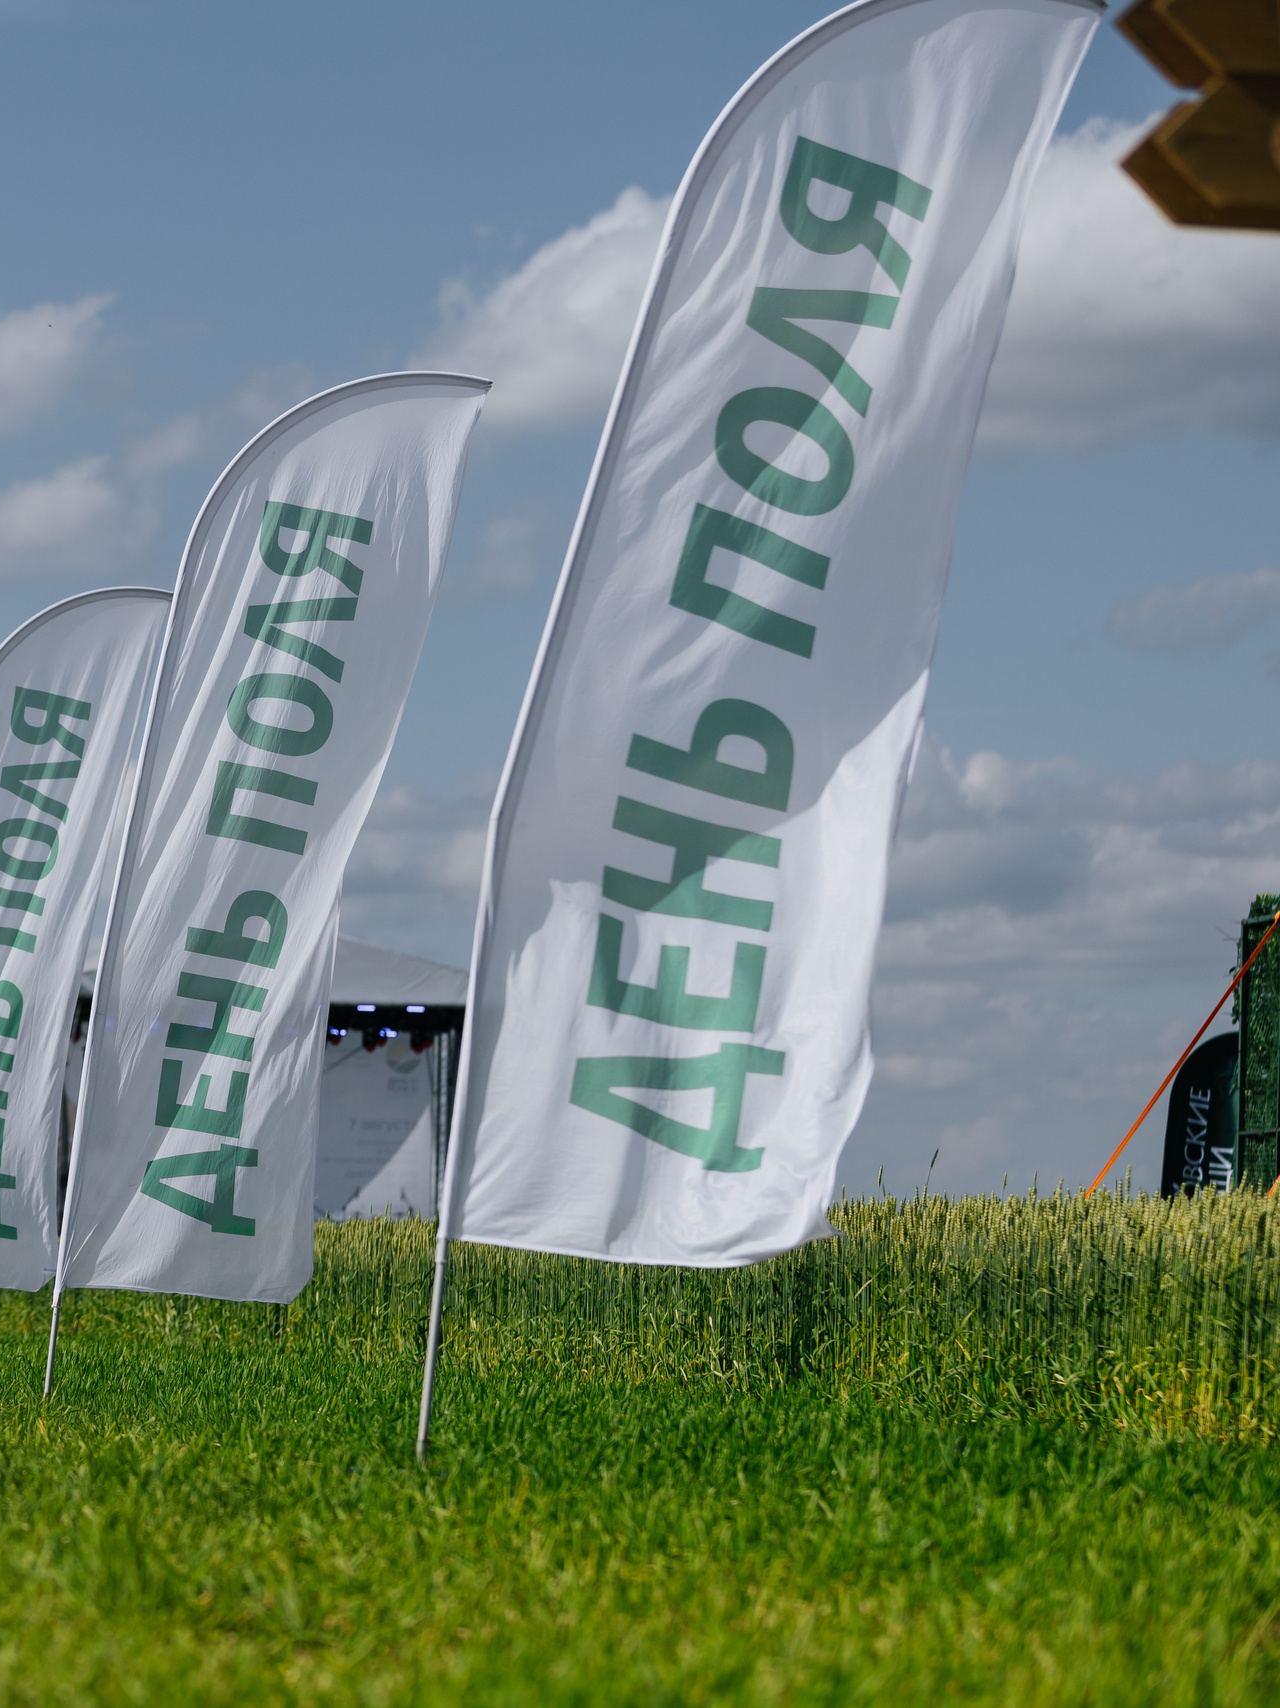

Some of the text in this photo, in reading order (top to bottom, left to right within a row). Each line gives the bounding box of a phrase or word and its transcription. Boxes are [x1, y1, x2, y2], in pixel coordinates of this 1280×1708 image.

[140, 501, 374, 1237] ДЕНЬ ПОЛЯ
[570, 136, 932, 1172] ДЕНЬ ПОЛЯ
